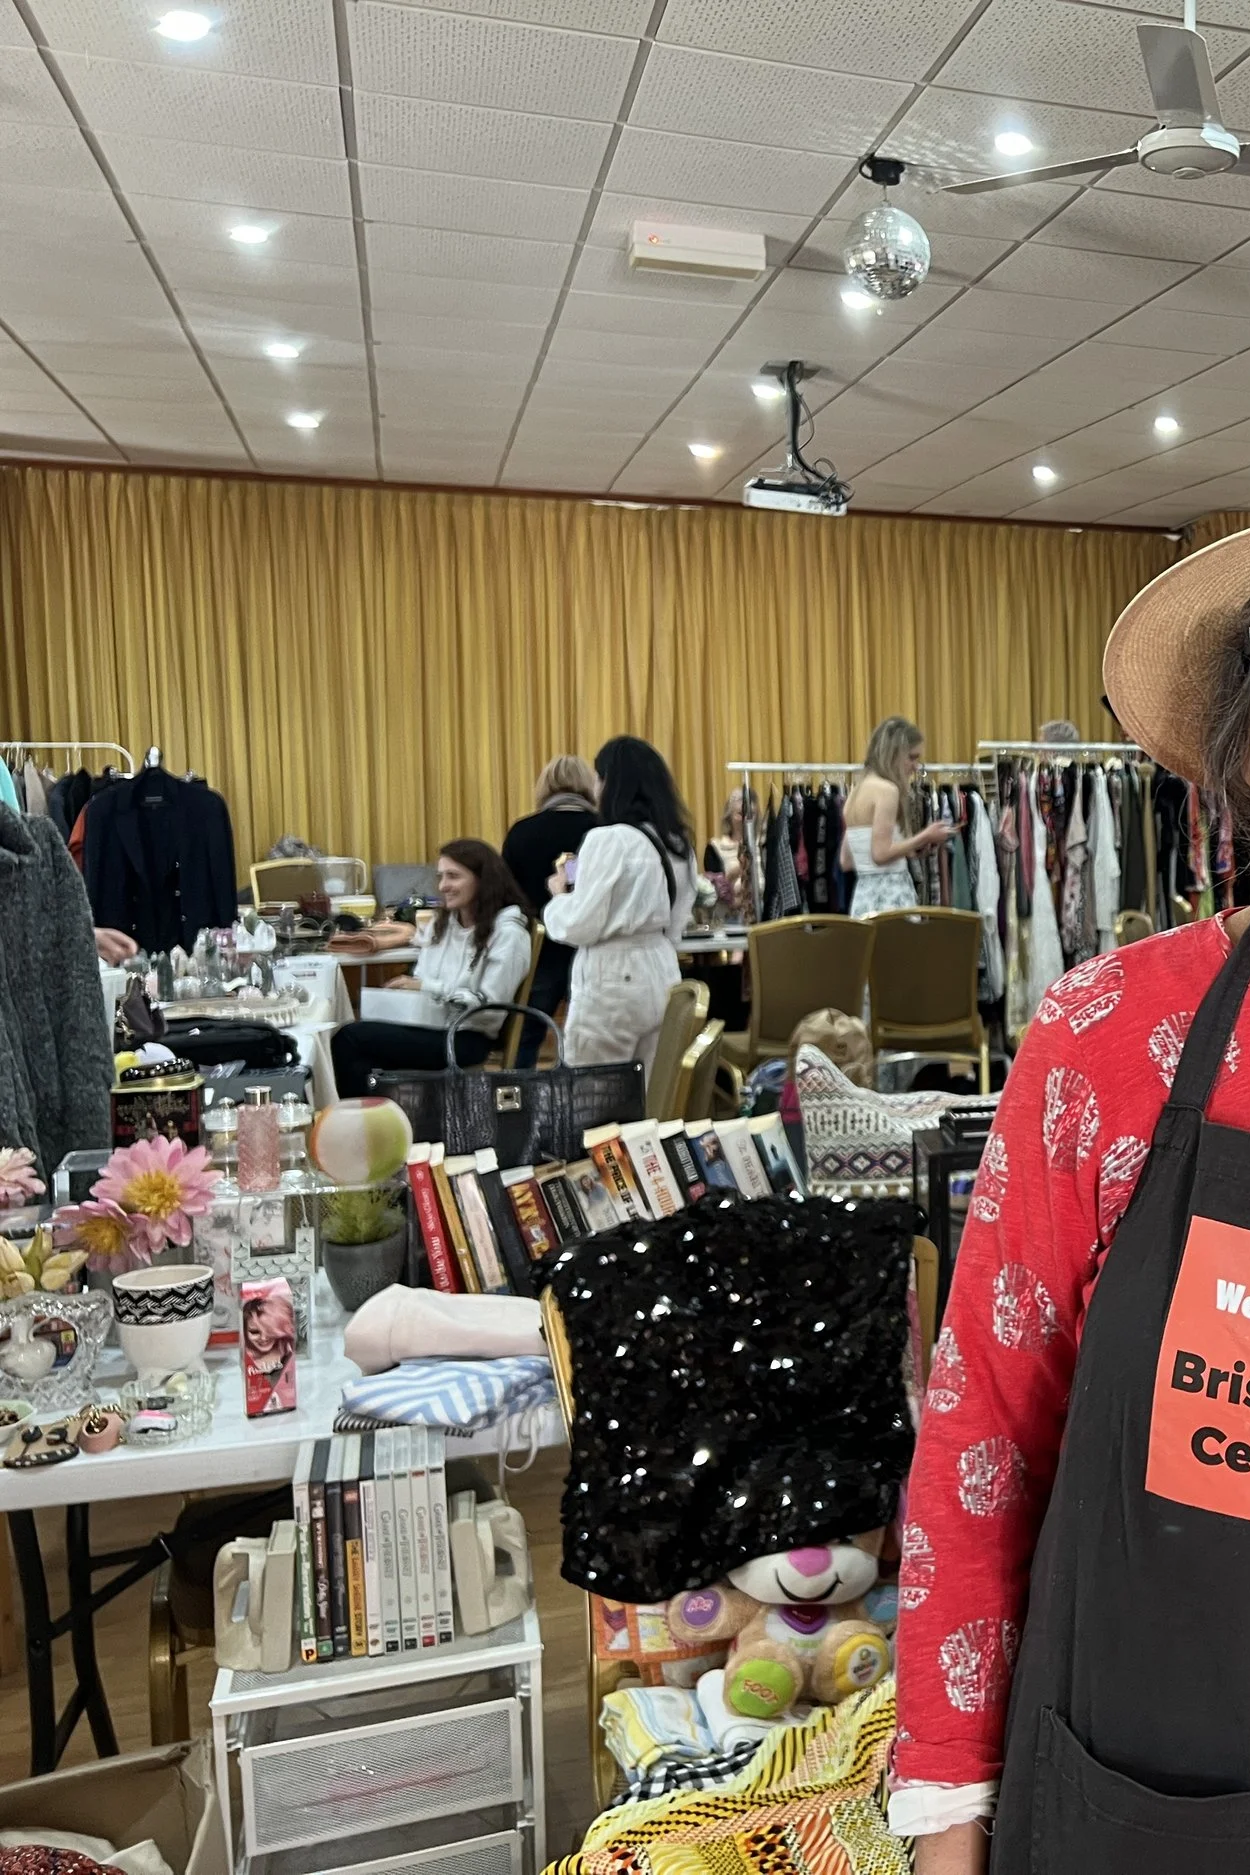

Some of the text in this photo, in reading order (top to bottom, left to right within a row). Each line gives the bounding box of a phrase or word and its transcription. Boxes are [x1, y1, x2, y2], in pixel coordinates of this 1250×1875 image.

[603, 1146, 616, 1164] THE
[620, 1191, 633, 1204] OF
[642, 1153, 661, 1176] THE
